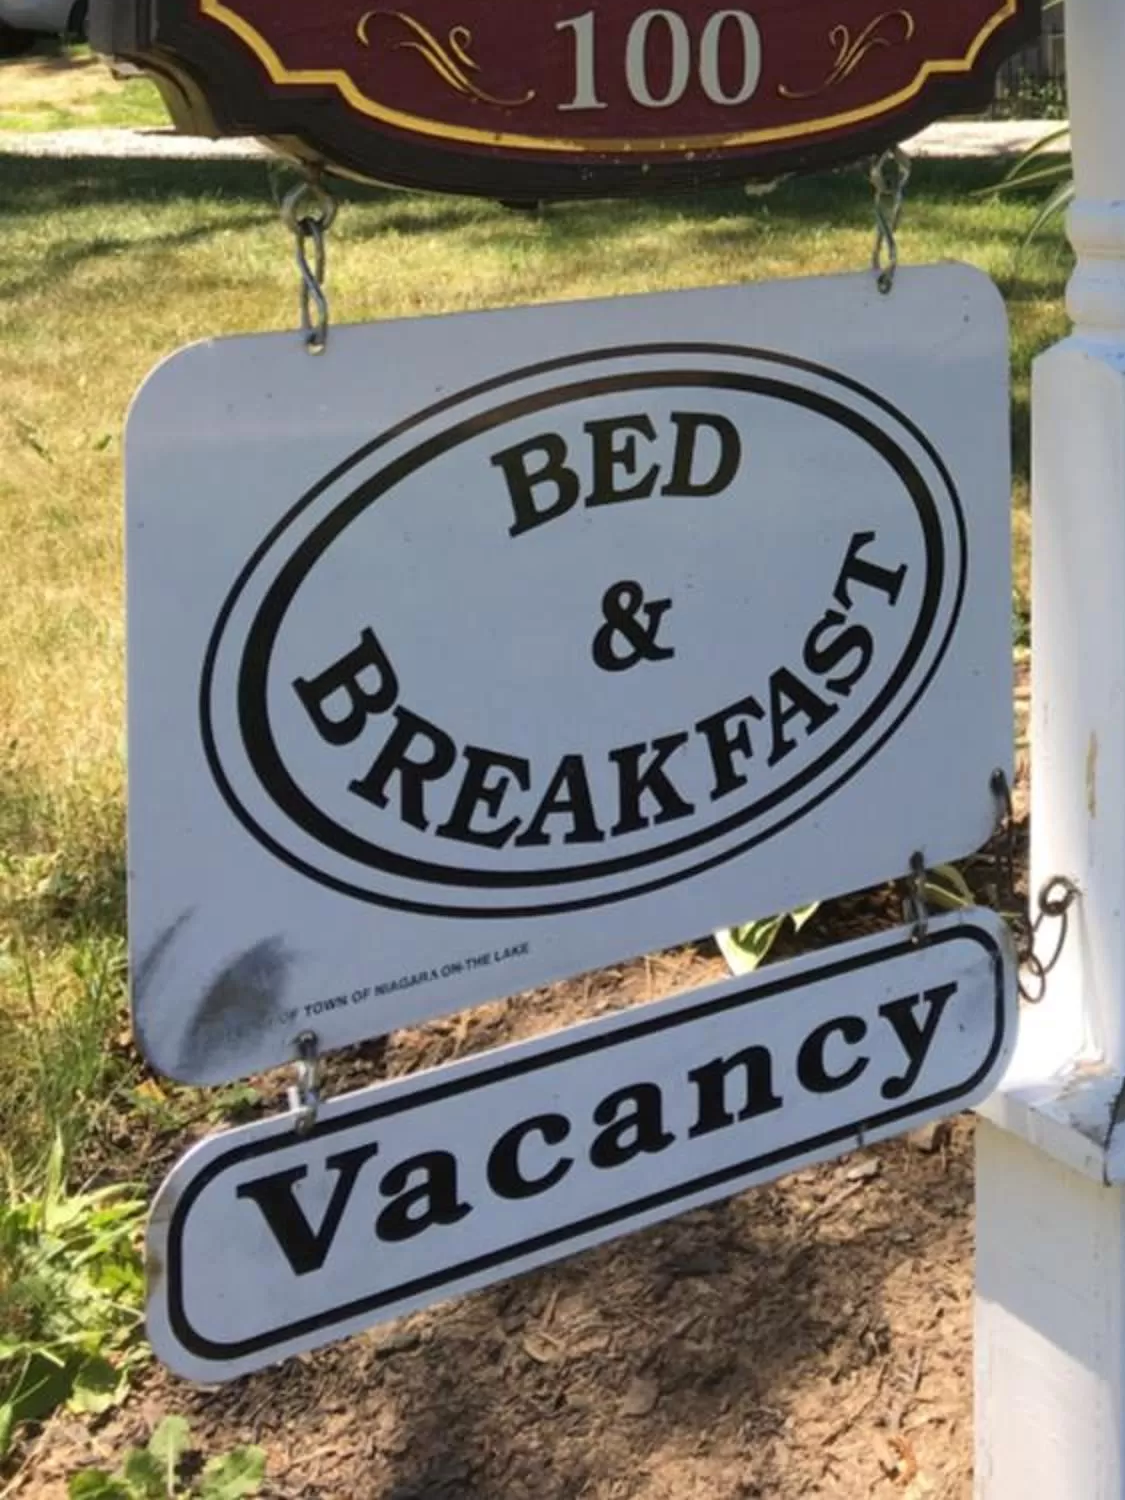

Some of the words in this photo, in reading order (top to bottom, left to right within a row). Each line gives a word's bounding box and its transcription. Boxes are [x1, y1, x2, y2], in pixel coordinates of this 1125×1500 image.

[555, 9, 762, 110] 100
[490, 411, 742, 538] BED
[591, 580, 675, 673] &
[291, 530, 908, 850] BREAKFAST
[304, 995, 347, 1016] TOWN
[351, 987, 371, 1004] OF
[374, 969, 439, 996] NIAGARA
[493, 941, 529, 963] LAKE
[235, 981, 959, 1277] Vacancy
